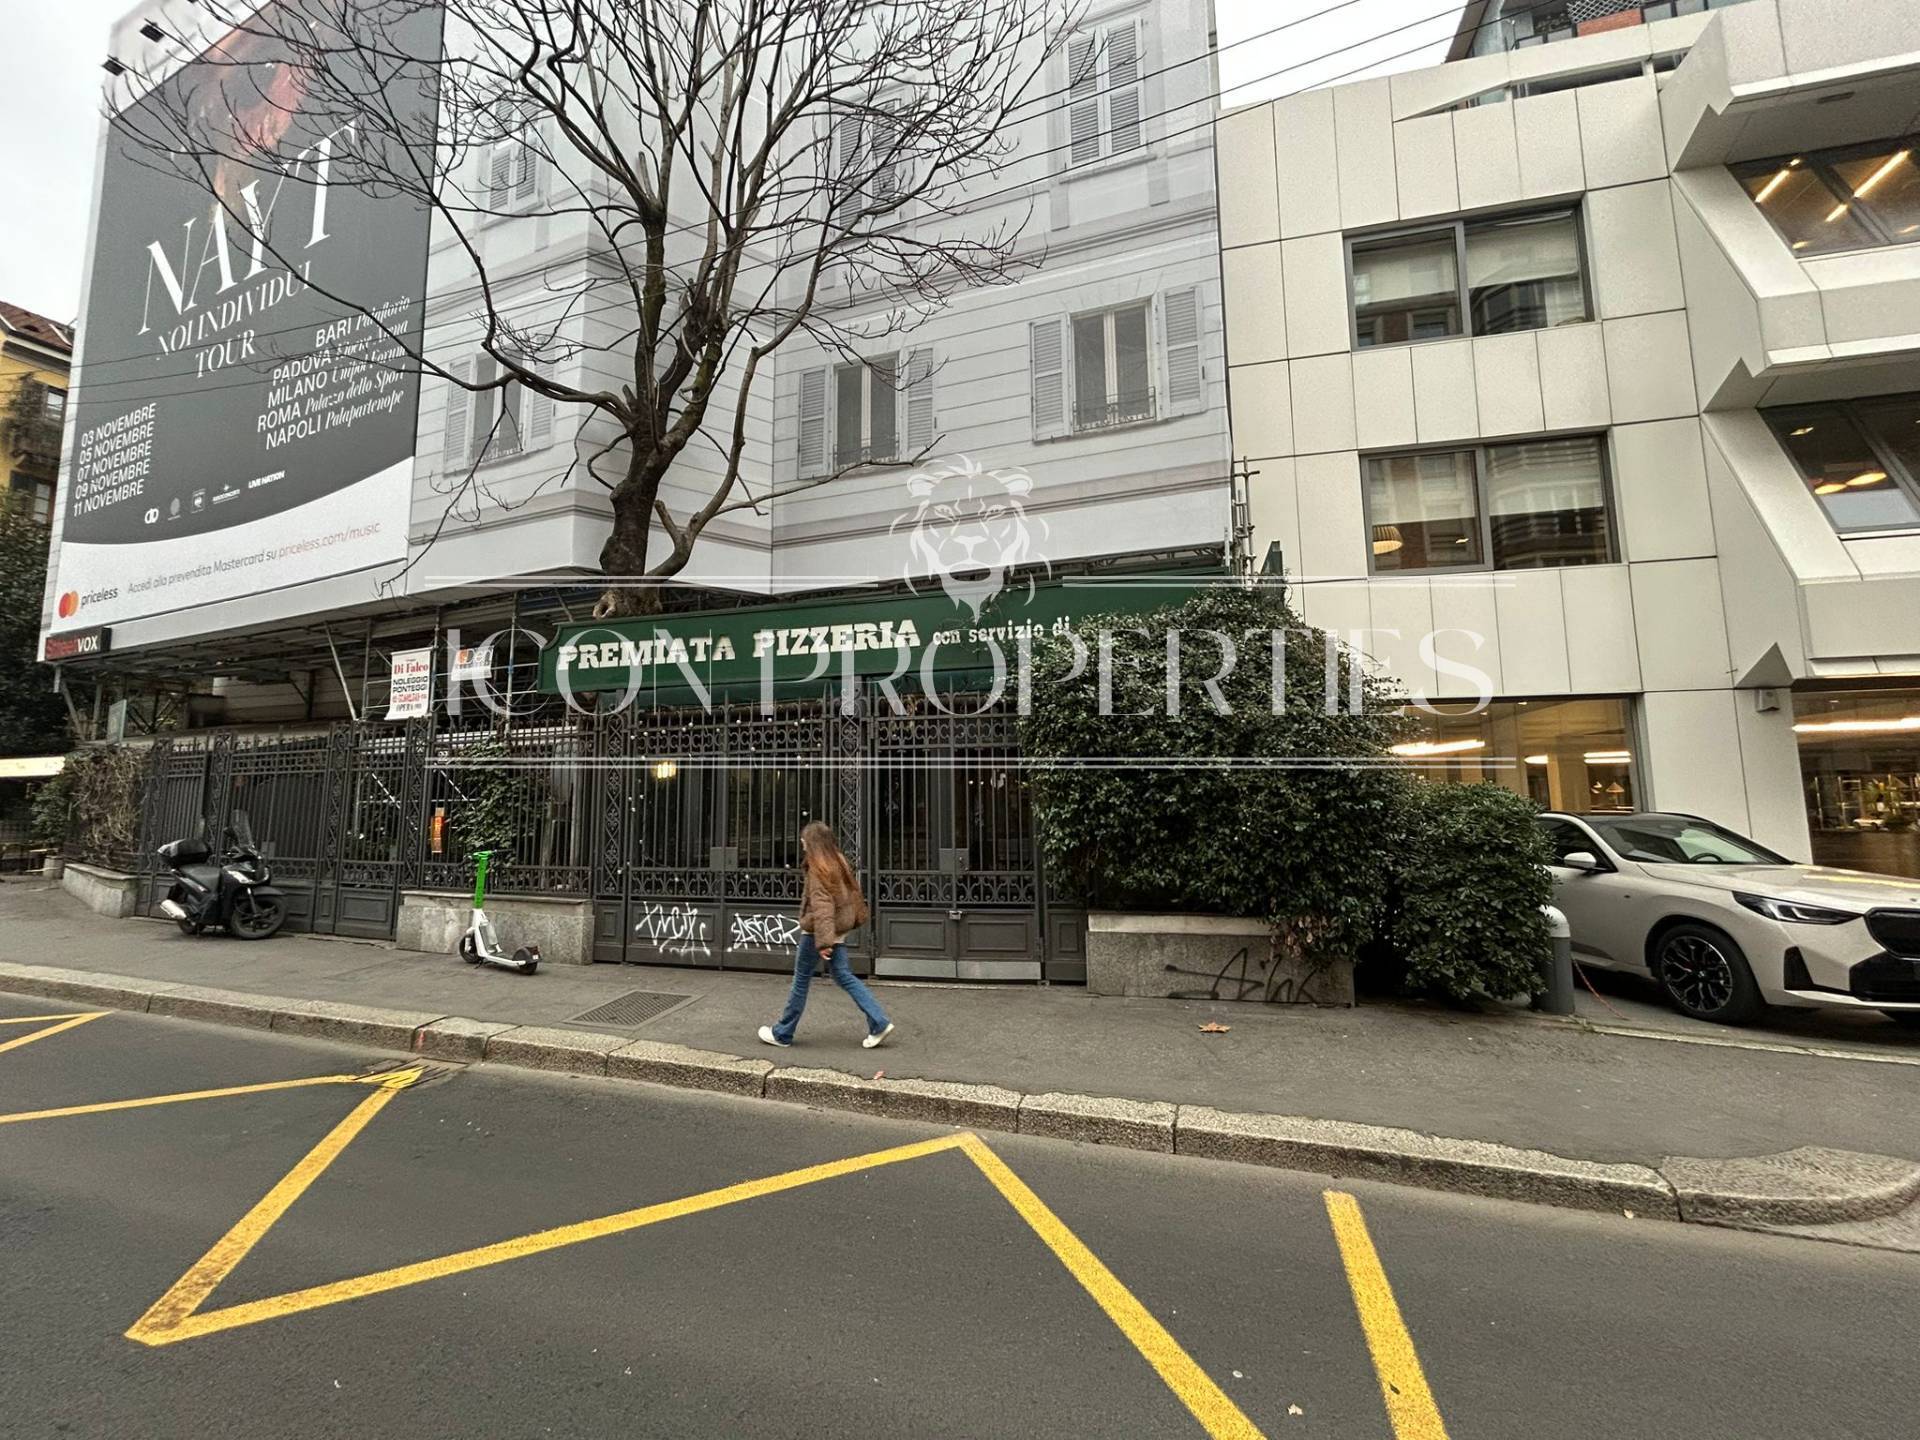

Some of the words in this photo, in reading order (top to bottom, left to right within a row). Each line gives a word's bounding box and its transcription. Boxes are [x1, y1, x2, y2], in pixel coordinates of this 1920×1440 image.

[137, 121, 355, 334] NAYT
[195, 329, 256, 378] TOUR
[315, 318, 352, 348] BARI
[273, 349, 332, 386] PADOVA
[257, 402, 301, 432] ROMA
[305, 391, 345, 415] Palazzo
[346, 379, 372, 400] dello
[267, 371, 328, 408] MILANO
[81, 430, 95, 447] 03
[95, 402, 157, 441] NOVEMBRE
[266, 414, 321, 450] NAPOLI
[324, 390, 404, 430] Palapartenope
[77, 464, 91, 482] 07
[91, 440, 152, 476] NOVEMBRE
[79, 447, 93, 465] 05
[93, 421, 155, 459] NOVEMBRE
[74, 501, 83, 517] 11
[84, 479, 145, 513] NOVEMBRE
[75, 482, 89, 500] 09
[90, 458, 151, 494] NOVEMBRE
[213, 552, 265, 573] Mastercard
[266, 551, 279, 562] su
[80, 586, 118, 607] priceless
[558, 636, 736, 671] PREMIATA
[753, 619, 921, 658] PIZZERIA
[932, 630, 962, 646] con
[968, 618, 1045, 643] servizio
[1052, 616, 1071, 637] di
[392, 684, 427, 694] PONTEGGI
[393, 675, 428, 686] NOLEGGIO
